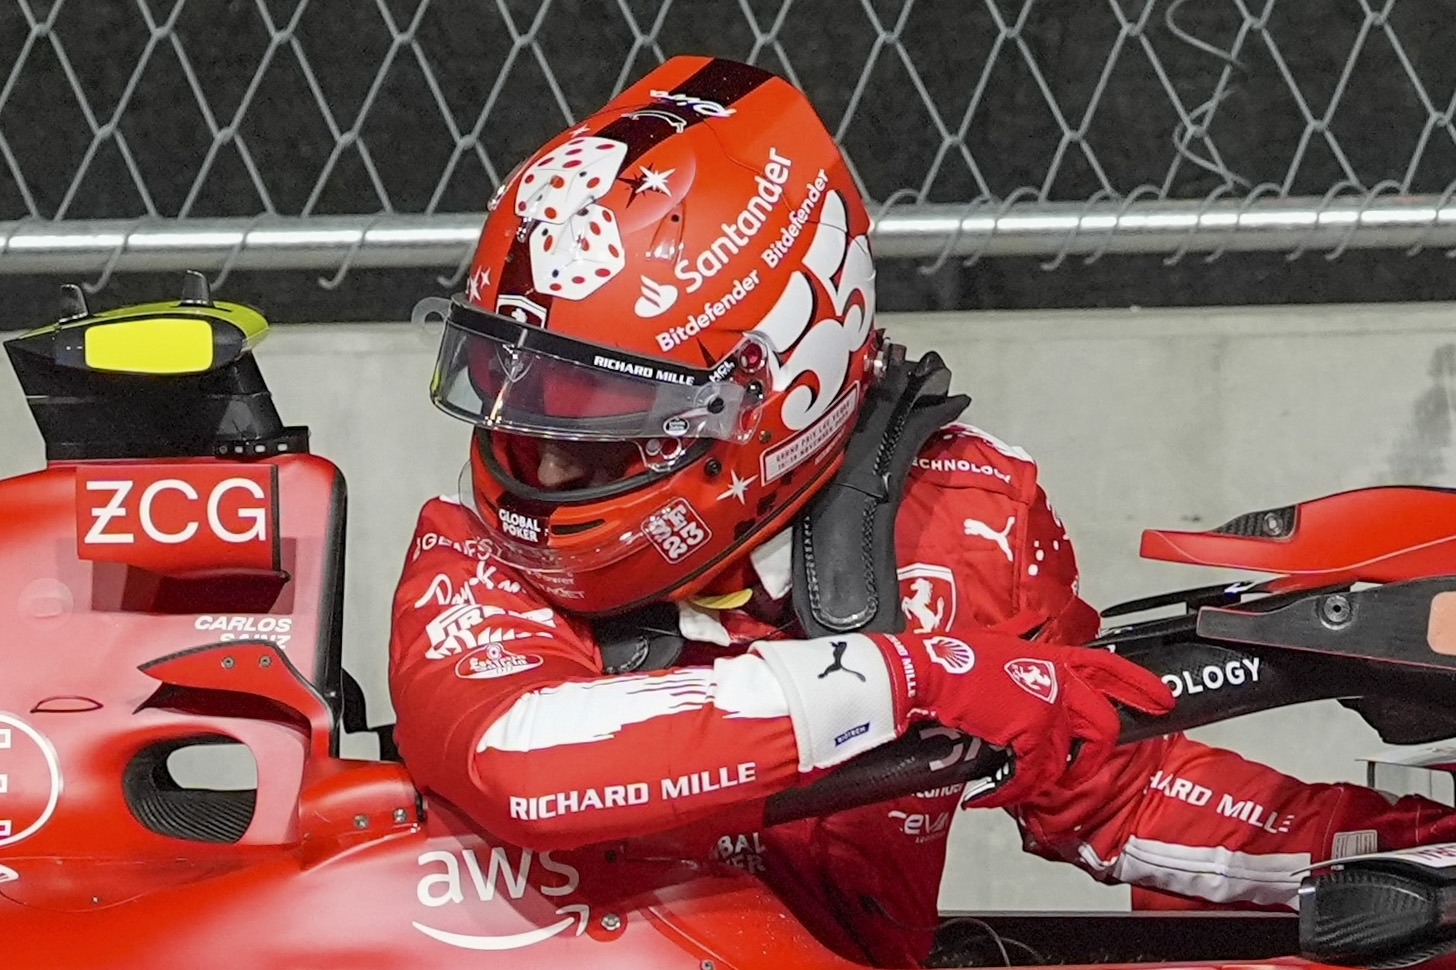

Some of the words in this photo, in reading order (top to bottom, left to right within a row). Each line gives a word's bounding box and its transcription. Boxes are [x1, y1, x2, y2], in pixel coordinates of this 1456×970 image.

[674, 147, 792, 294] Santander
[654, 269, 760, 353] Bitdefender
[760, 168, 830, 269] Bitdefender
[594, 355, 653, 379] RICHARD
[655, 370, 695, 386] MILLE
[498, 508, 541, 532] GLOBAL
[502, 521, 539, 543] POKER
[662, 521, 705, 559] 23
[194, 615, 292, 632] CARLOS
[509, 782, 650, 820] RICHARD
[661, 762, 757, 801] MILLE
[1216, 793, 1295, 834] MILLE
[416, 846, 580, 907] aws
